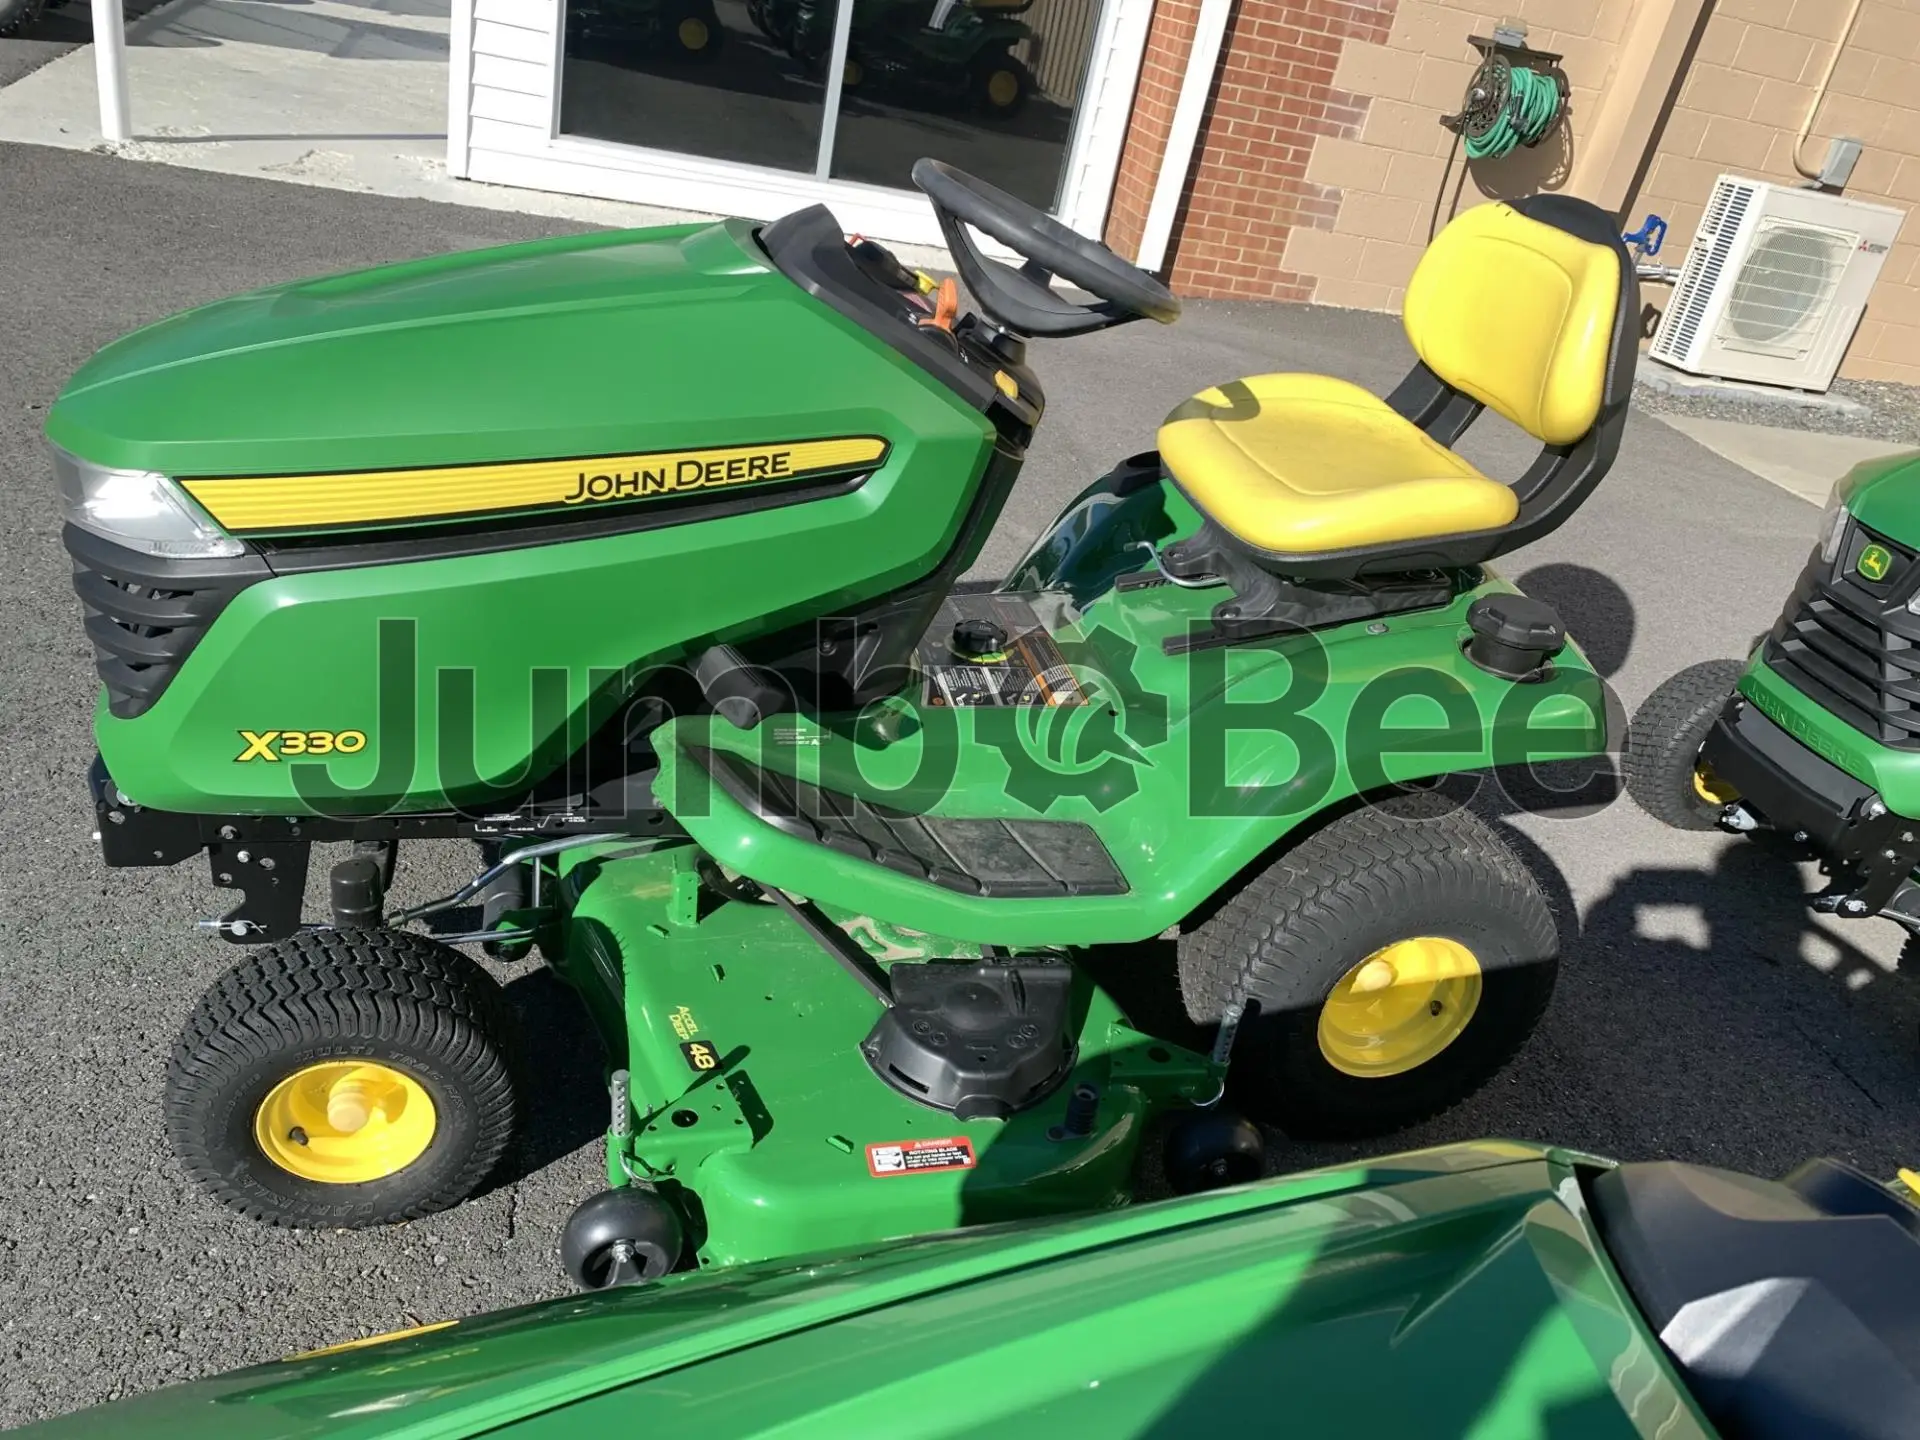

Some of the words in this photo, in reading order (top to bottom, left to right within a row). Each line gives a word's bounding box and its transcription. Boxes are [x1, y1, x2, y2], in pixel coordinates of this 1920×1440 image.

[564, 467, 665, 500] JOHN
[676, 451, 791, 487] DEERE
[232, 729, 367, 762] X330
[689, 1043, 715, 1069] 48
